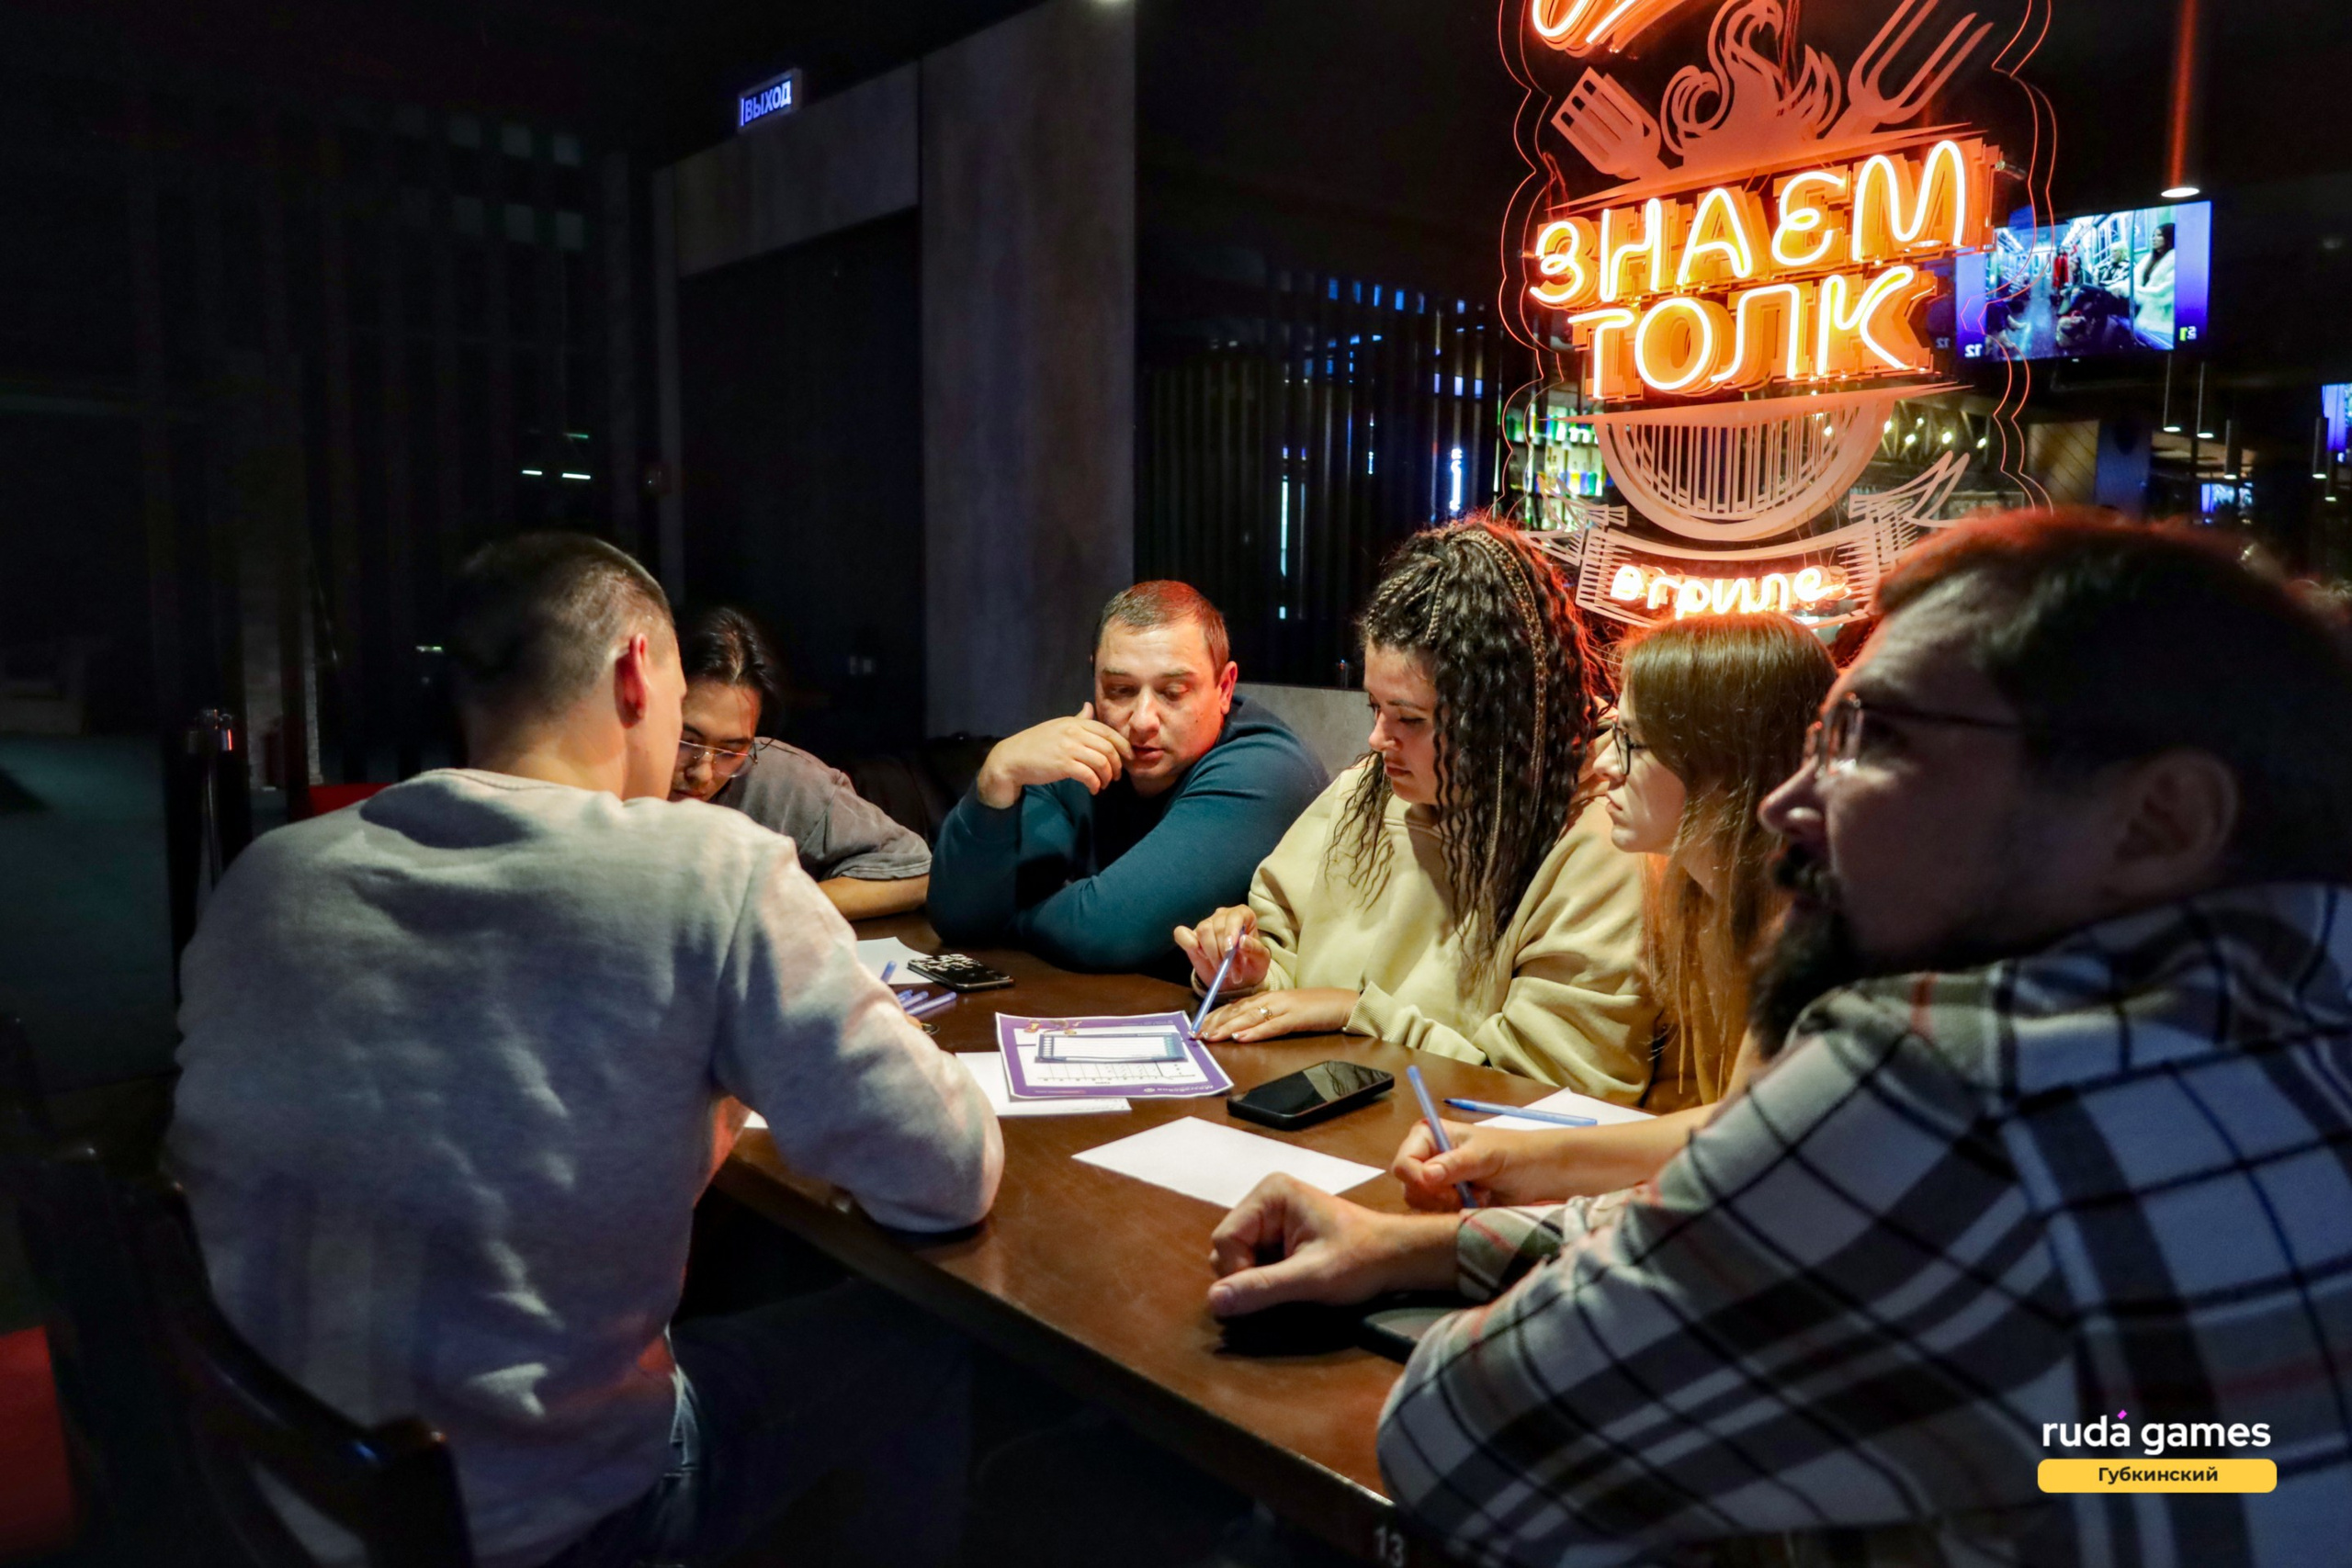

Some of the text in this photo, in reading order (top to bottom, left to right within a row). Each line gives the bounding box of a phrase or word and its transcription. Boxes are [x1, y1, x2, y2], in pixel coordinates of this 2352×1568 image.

[744, 80, 791, 123] ВЫХОД
[1529, 140, 1972, 305] ЗНАЕМ
[1567, 266, 1917, 400] ТОЛК
